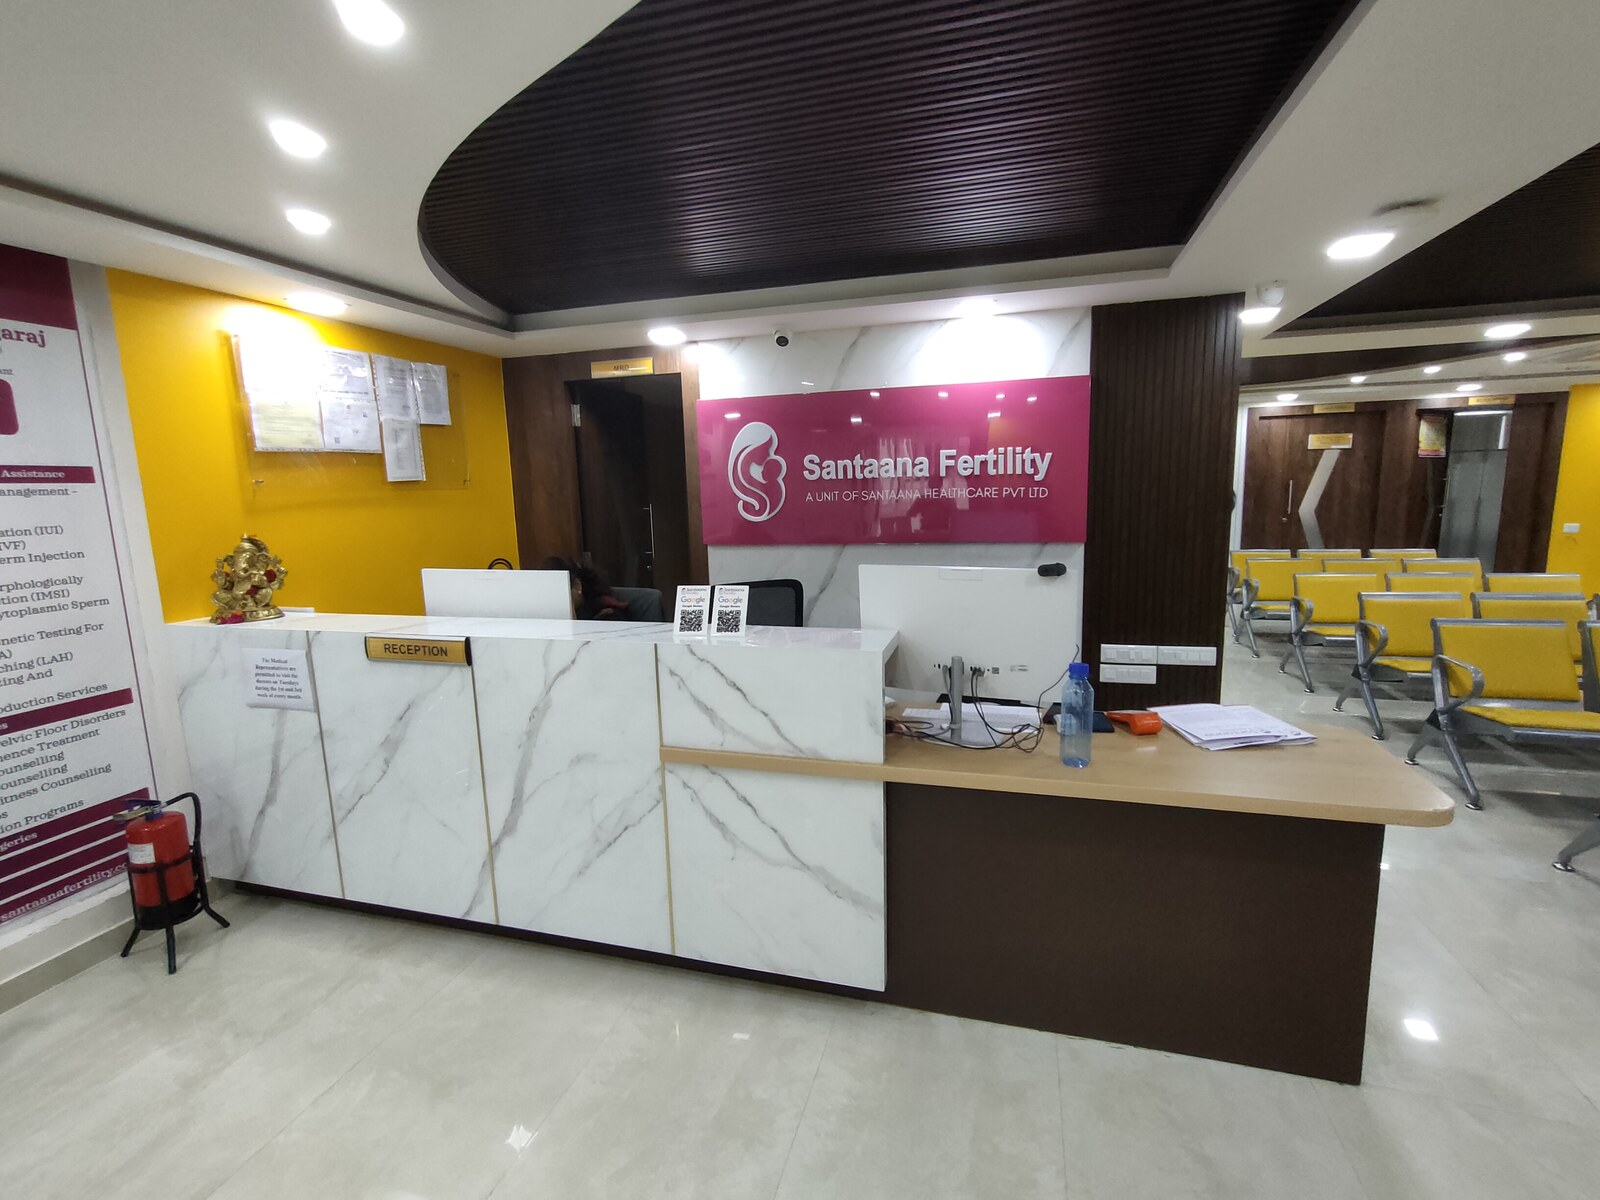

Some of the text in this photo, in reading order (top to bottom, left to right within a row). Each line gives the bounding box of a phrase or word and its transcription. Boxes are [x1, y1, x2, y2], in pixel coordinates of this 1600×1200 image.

[0, 329, 46, 348] araj
[803, 447, 1052, 481] Santaana Fertility
[1, 470, 65, 478] Assistance
[0, 488, 70, 498] anagement
[805, 487, 1049, 502] A UNIT OF SANTAANA HEALTHCARE PVT LTD
[0, 525, 64, 537] ation (IUI)
[0, 551, 85, 565] erm Injection
[0, 576, 83, 593] rphologically
[30, 589, 70, 602] (IMSI)
[681, 596, 706, 604] Google
[718, 596, 743, 605] Google
[0, 598, 110, 620] ytoplasmic Sperm
[0, 623, 104, 646] netic Testing For
[383, 643, 448, 657] RECEPTION
[36, 651, 73, 666] (LAH)
[26, 669, 53, 681] And
[57, 683, 108, 700] Services
[0, 709, 126, 747] elvic Floor Disorders
[36, 728, 100, 752] Treatment
[0, 763, 68, 790] ounselling
[0, 763, 112, 806] itness Counselling
[0, 800, 84, 834] ion Programs
